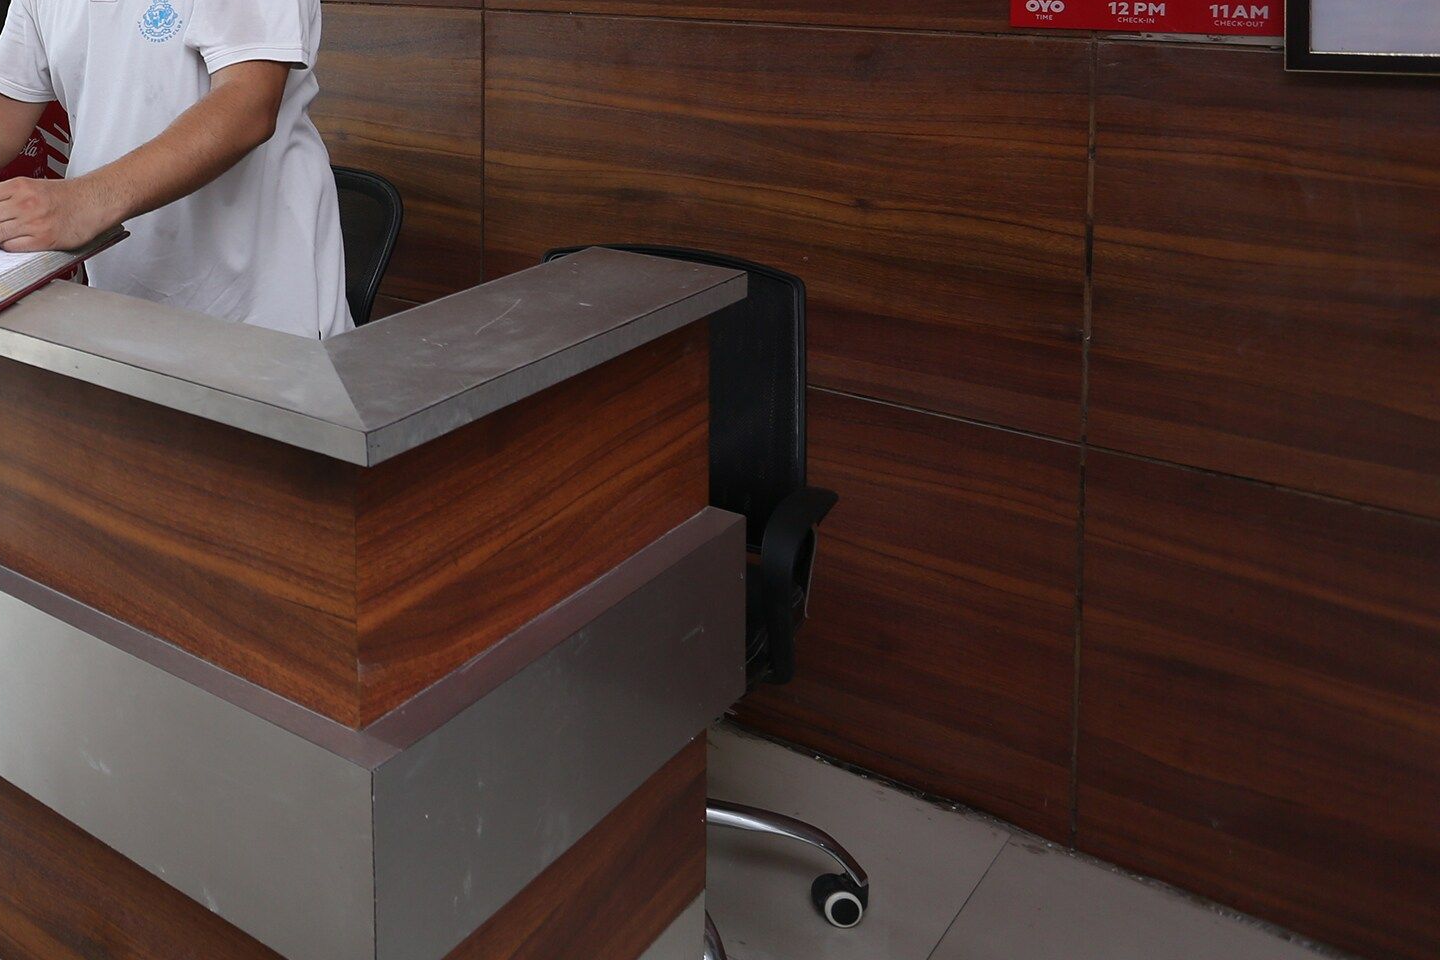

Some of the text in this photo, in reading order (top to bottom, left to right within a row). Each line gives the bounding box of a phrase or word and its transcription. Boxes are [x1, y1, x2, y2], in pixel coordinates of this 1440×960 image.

[1025, 0, 1065, 13] OYO
[1108, 2, 1166, 16] 12 PM
[1214, 20, 1264, 28] CHECK-OUT
